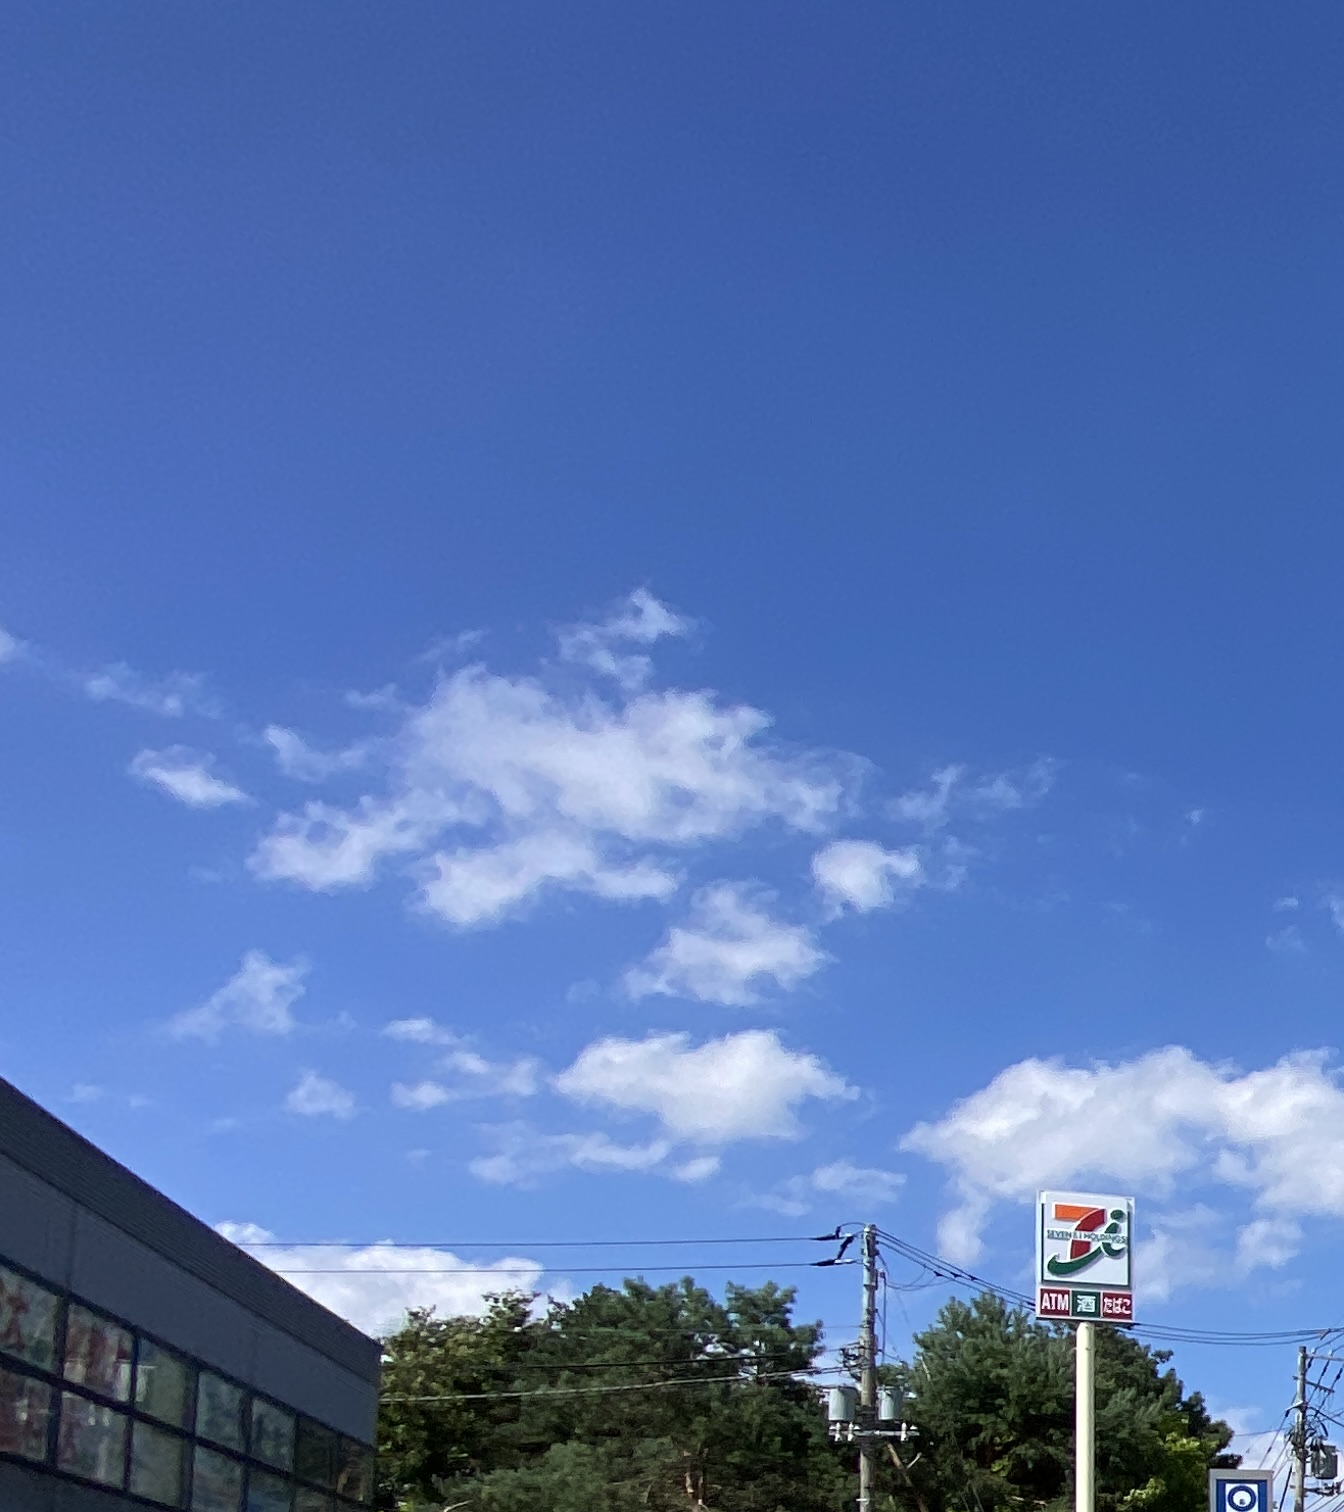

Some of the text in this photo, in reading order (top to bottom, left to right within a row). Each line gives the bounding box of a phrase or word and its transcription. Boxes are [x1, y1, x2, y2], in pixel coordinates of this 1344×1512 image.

[1047, 1229, 1072, 1240] SEVEN
[1041, 1293, 1069, 1311] ATM
[1077, 1295, 1096, 1313] 酒
[1103, 1297, 1132, 1315] たばこ
